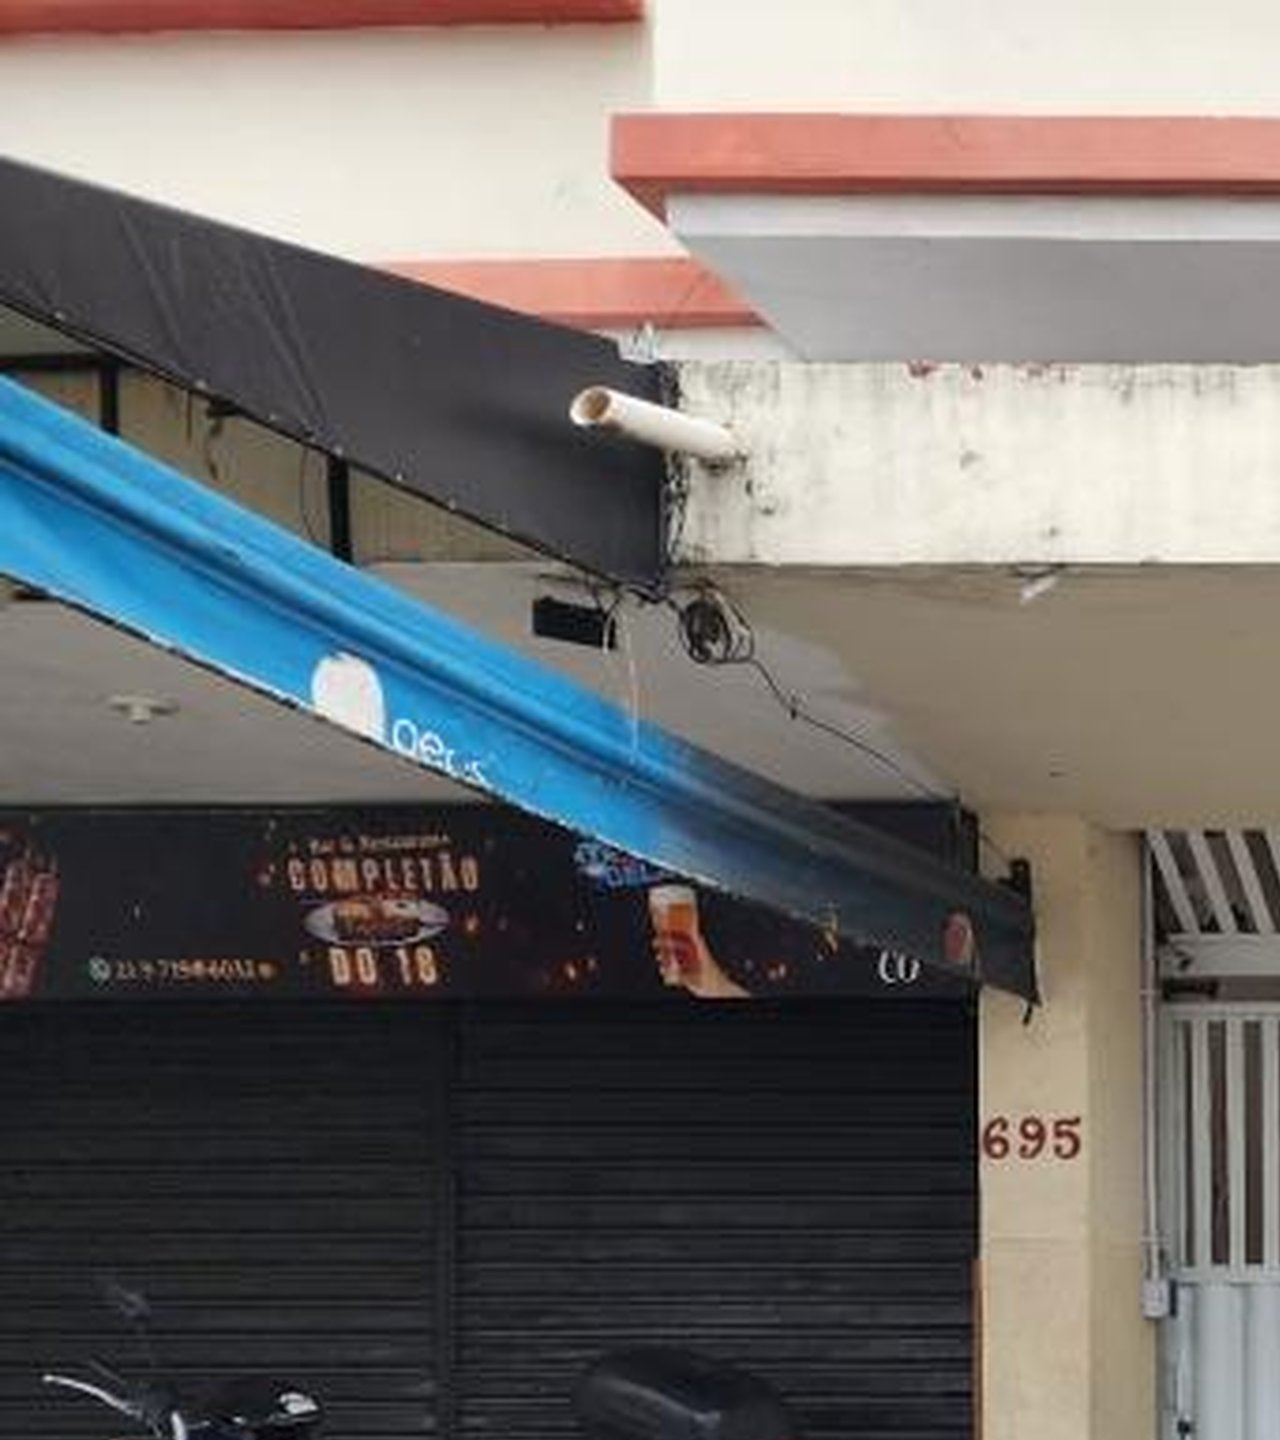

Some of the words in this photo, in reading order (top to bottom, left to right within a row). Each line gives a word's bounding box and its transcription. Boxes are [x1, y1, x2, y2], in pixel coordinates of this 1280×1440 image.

[287, 853, 480, 891] COMPLETÃO
[329, 946, 378, 986] DO
[396, 945, 438, 986] 18
[982, 1116, 1082, 1160] 695
